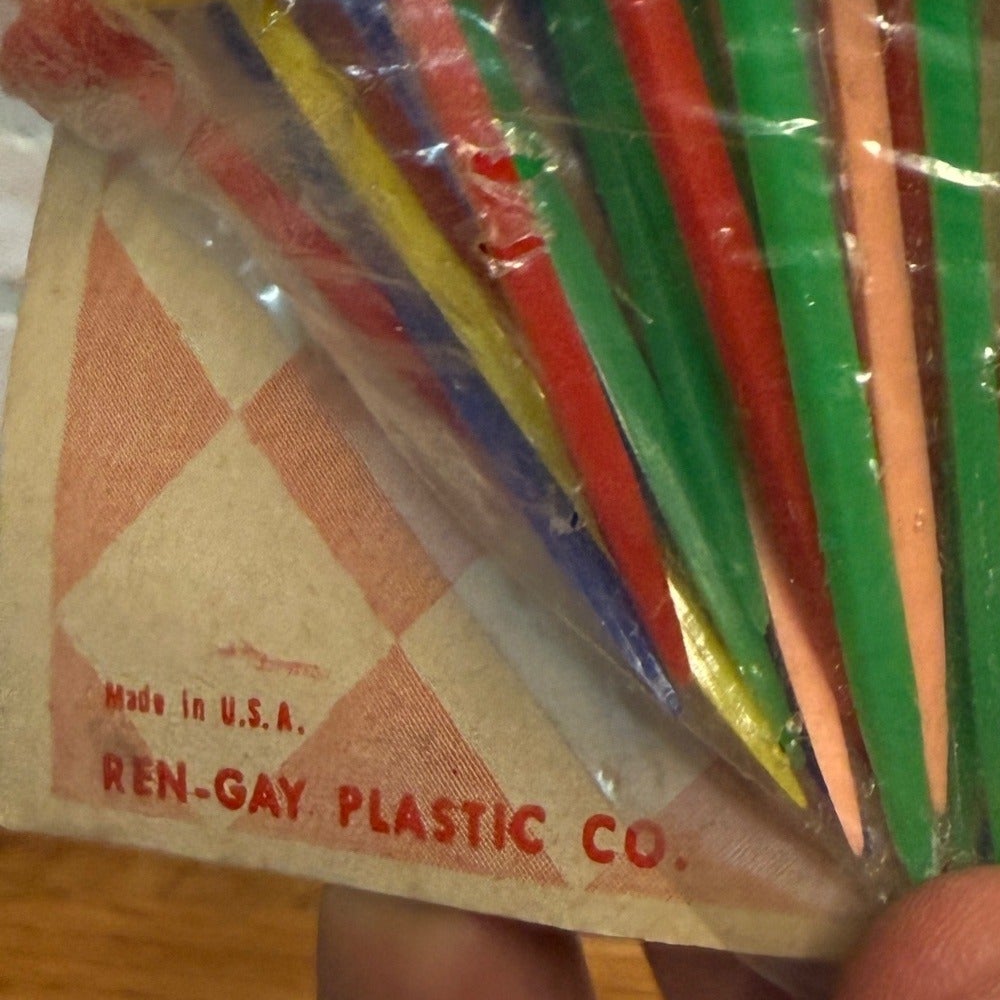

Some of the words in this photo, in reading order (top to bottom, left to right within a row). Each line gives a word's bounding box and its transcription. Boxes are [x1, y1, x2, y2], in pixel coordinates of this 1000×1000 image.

[104, 681, 165, 716] Made
[182, 687, 206, 722] in
[220, 695, 306, 735] U.S.A.
[102, 752, 307, 822] REN-GAY
[337, 785, 548, 855] PLASTIC
[582, 814, 690, 872] CO.
